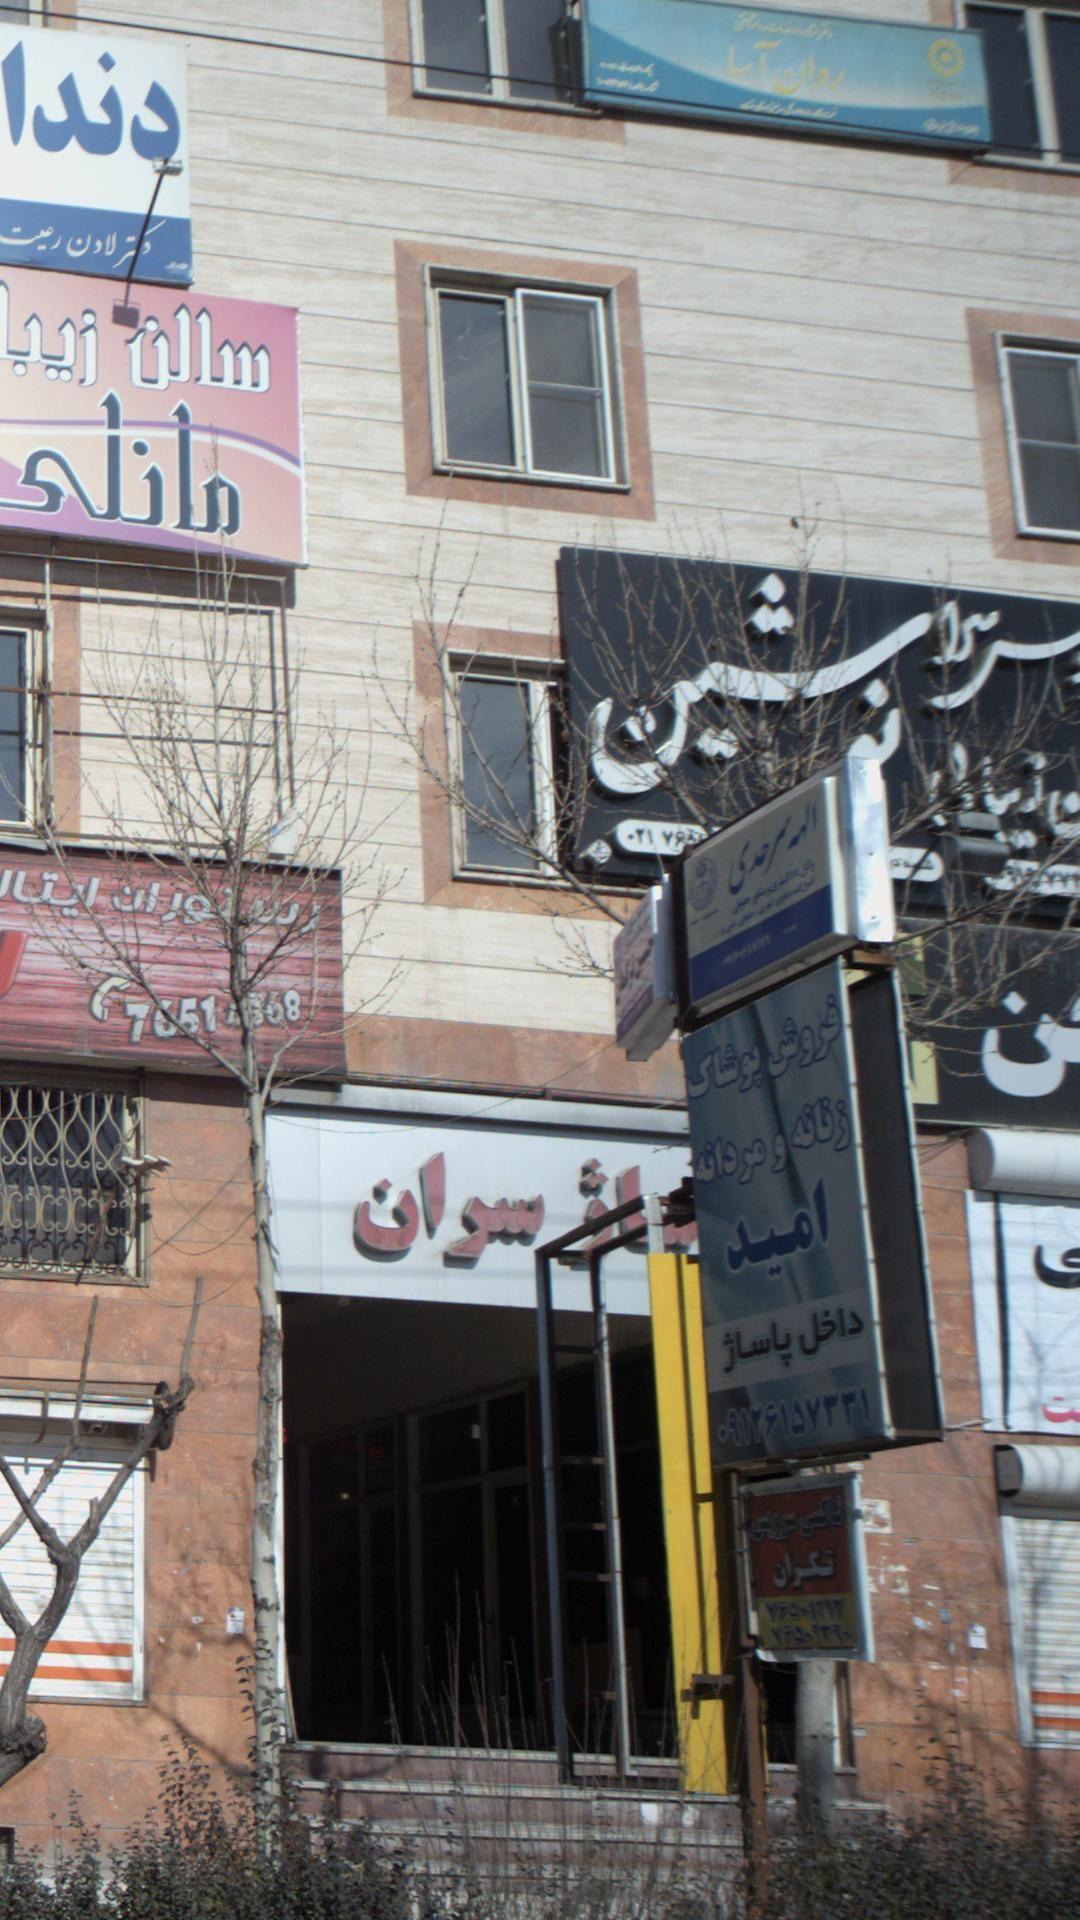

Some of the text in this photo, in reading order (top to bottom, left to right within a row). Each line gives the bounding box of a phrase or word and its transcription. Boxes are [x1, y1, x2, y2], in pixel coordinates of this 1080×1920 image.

[66, 231, 118, 257] لادن
[112, 219, 168, 269] دکتر
[125, 302, 270, 393] سالن
[689, 992, 841, 1100] فروش پوشاک
[694, 1096, 852, 1185] زنانه و مردانه
[354, 1152, 545, 1267] سران
[726, 1177, 829, 1278] امید
[723, 1306, 865, 1375] داخل پاساژ
